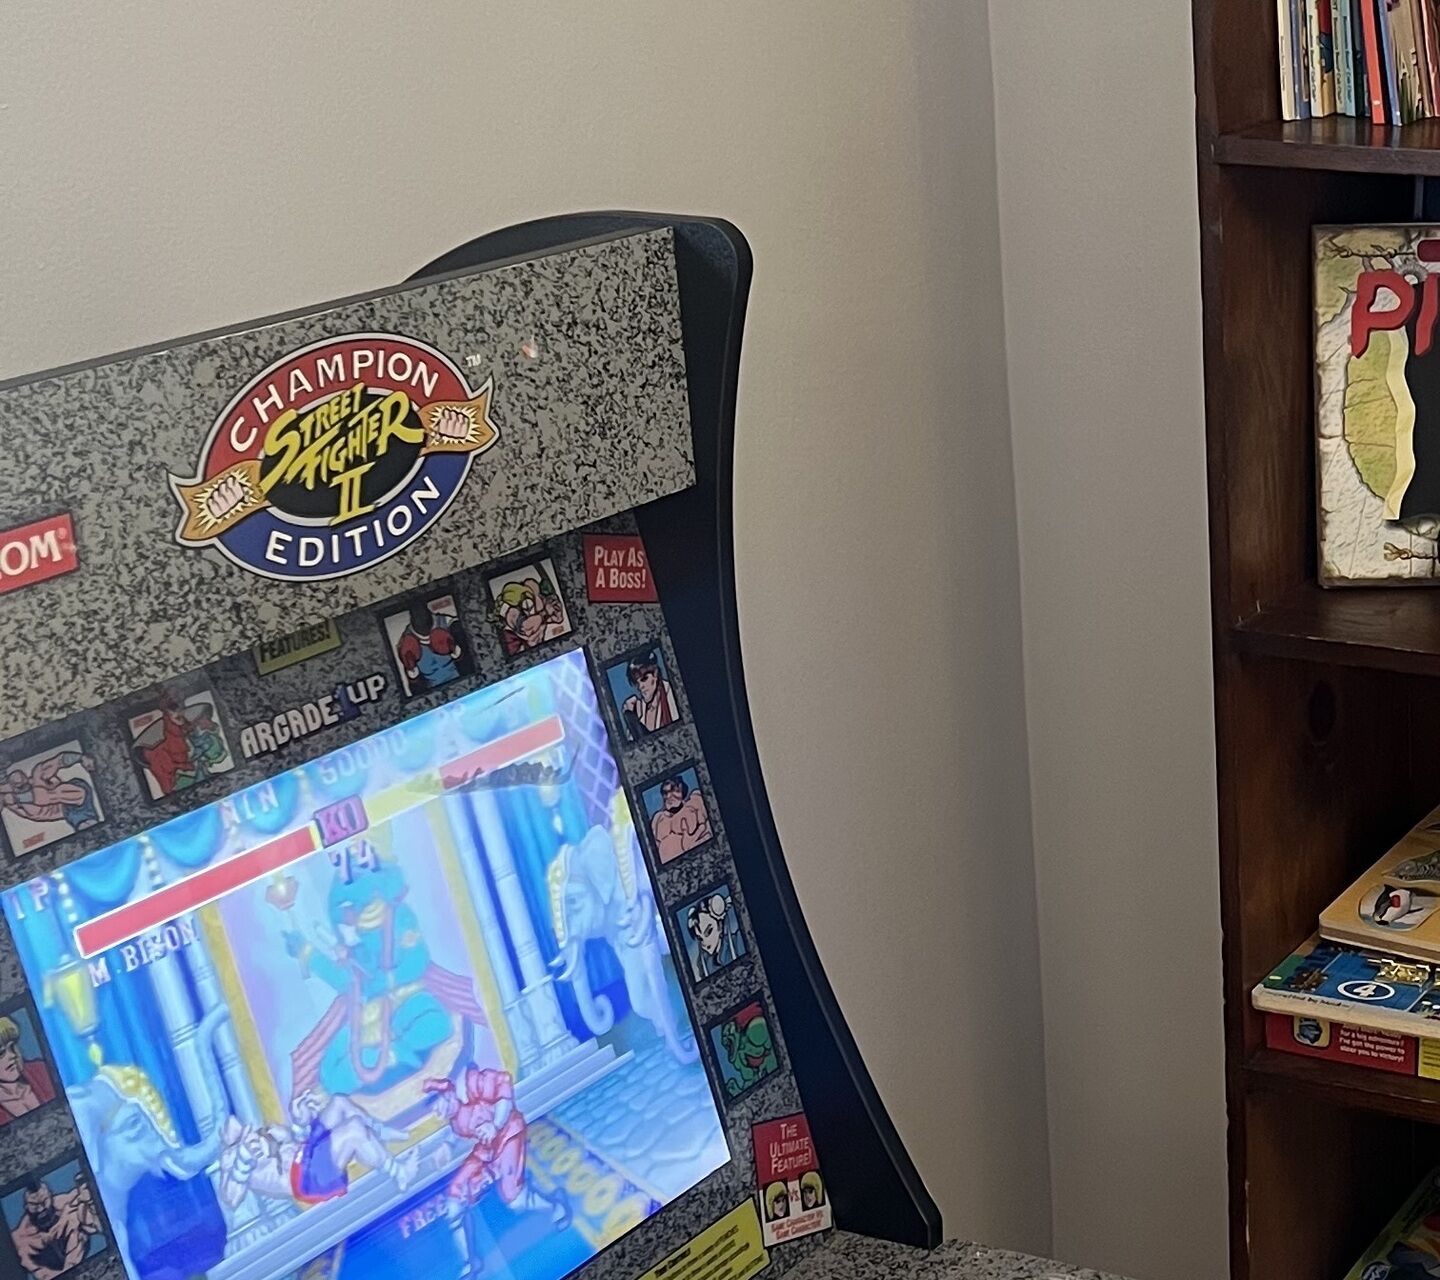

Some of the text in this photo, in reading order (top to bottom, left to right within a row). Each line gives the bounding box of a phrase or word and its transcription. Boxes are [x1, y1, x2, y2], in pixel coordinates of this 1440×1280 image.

[229, 349, 439, 452] CHAMPION
[258, 382, 365, 494] STREET
[283, 390, 425, 490] FIGHTER
[265, 476, 441, 567] EDITION
[329, 462, 376, 526] II
[595, 568, 646, 588] A BOSS!
[240, 674, 386, 759] ARCADE1UP
[120, 915, 199, 972] BISON
[1353, 984, 1377, 997] 4
[769, 1137, 810, 1158] ULTIMATE
[780, 1123, 798, 1140] THE
